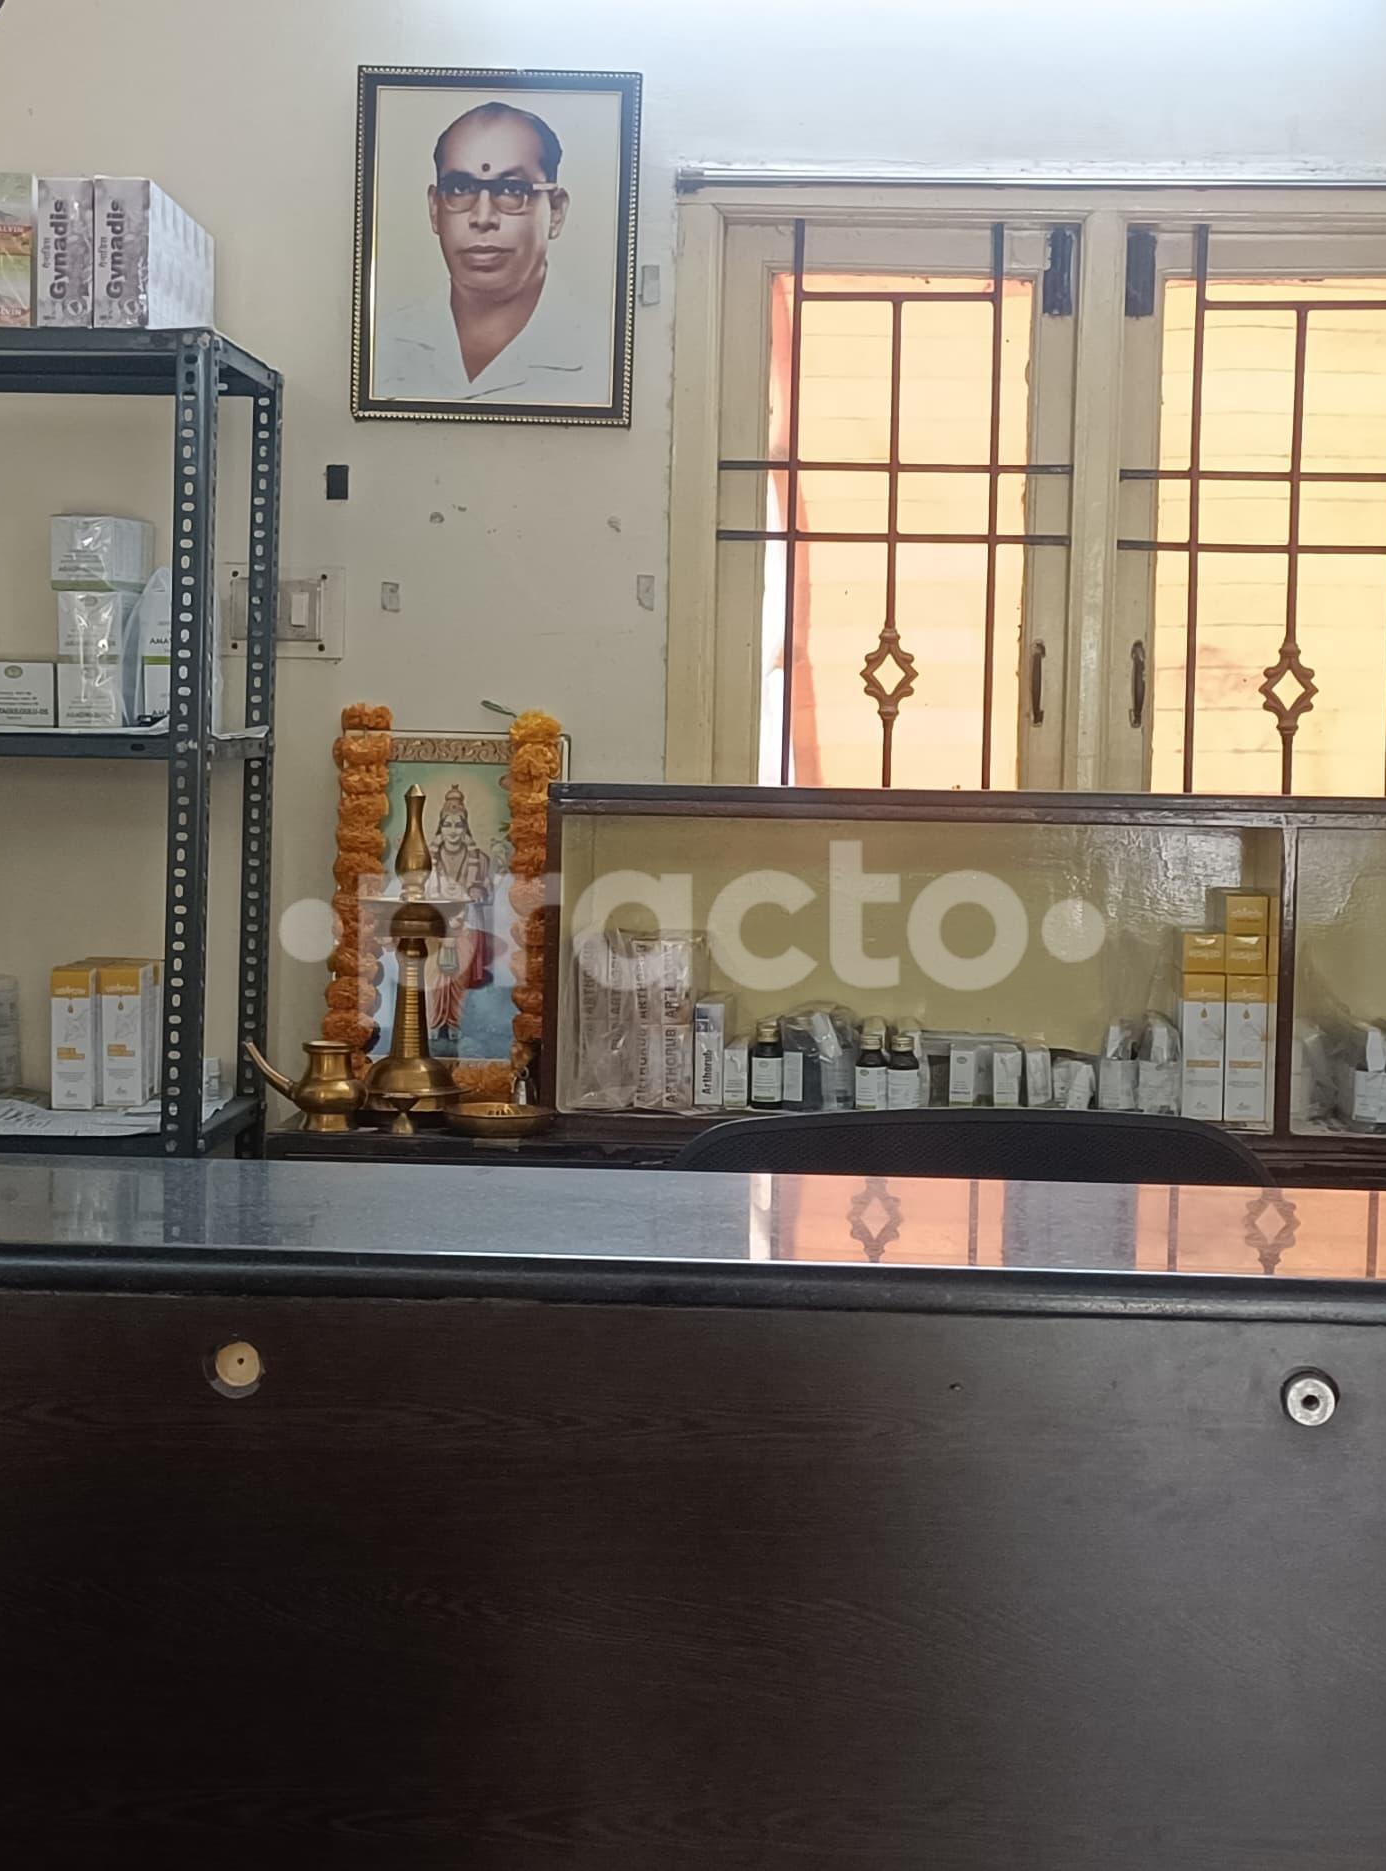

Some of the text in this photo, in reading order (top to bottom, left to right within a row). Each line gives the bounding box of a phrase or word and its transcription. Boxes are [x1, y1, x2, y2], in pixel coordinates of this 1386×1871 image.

[49, 200, 68, 299] Gynadis
[106, 200, 126, 299] Gynadis
[665, 1028, 677, 1103] ARTHORUB
[702, 1049, 713, 1095] Arthorub
